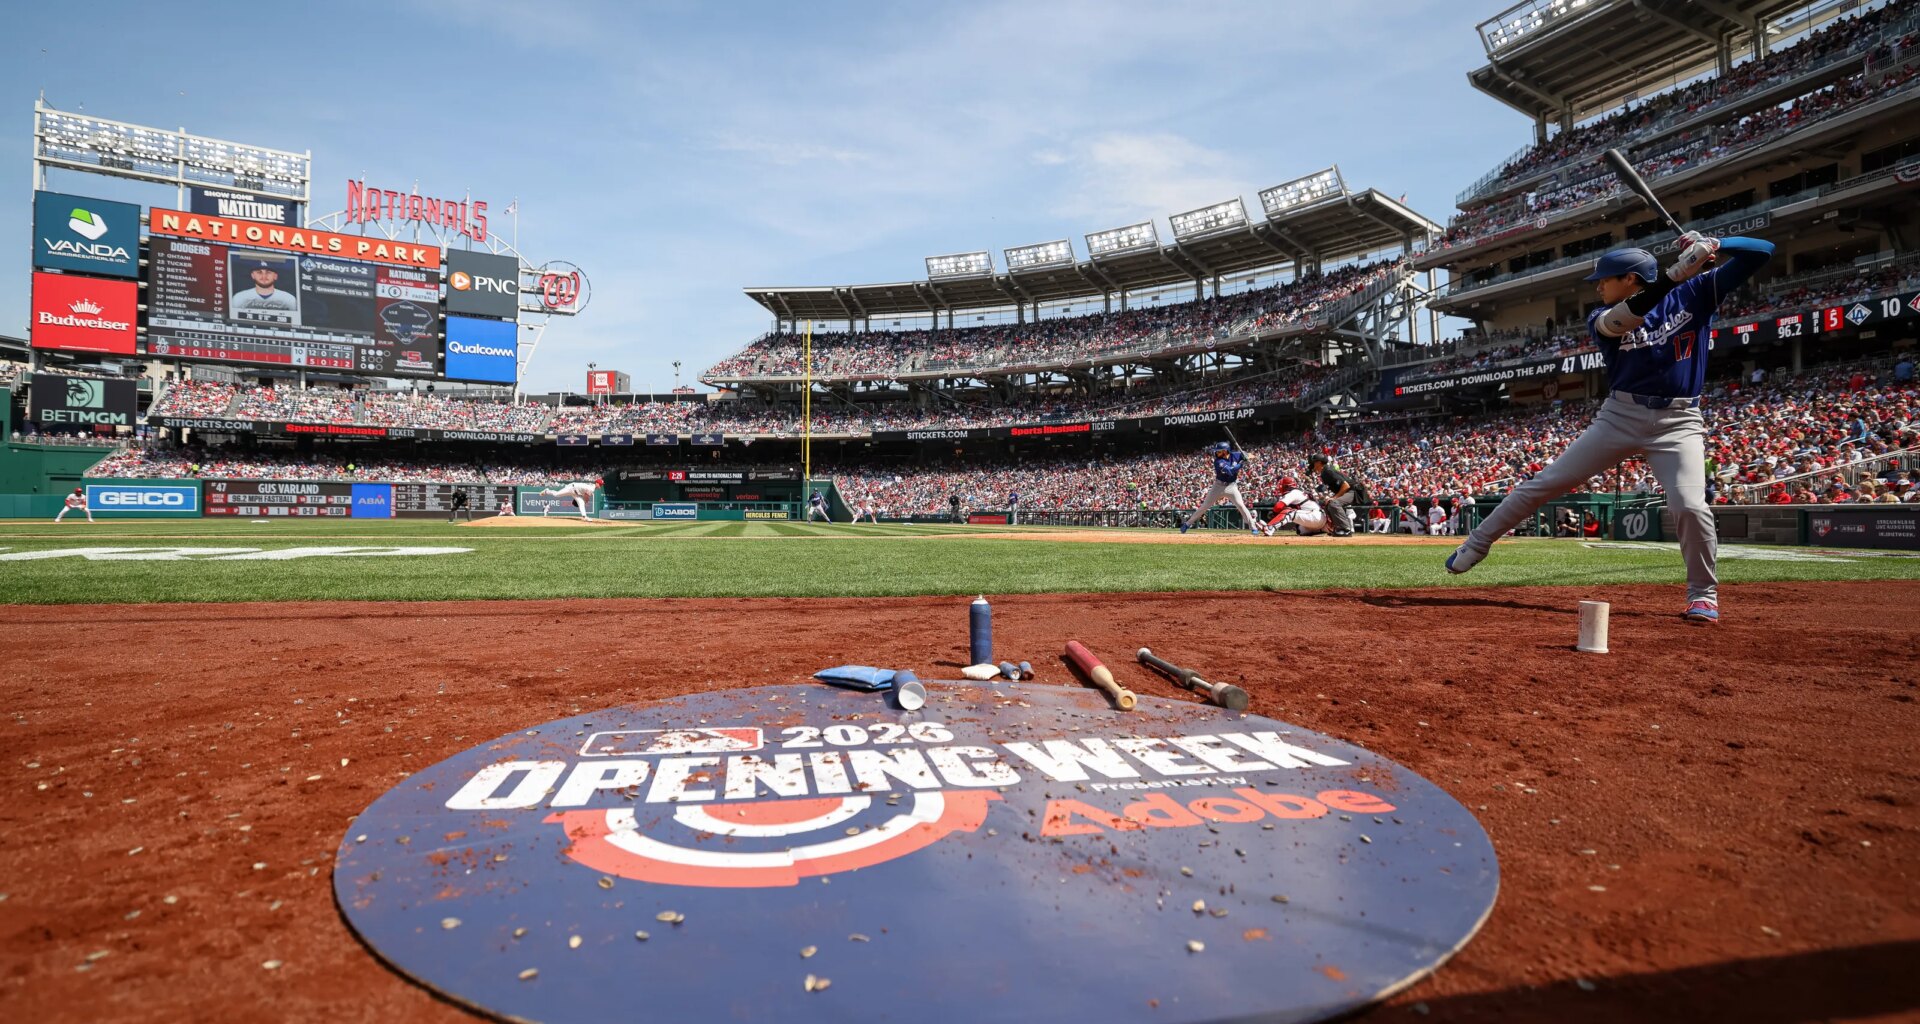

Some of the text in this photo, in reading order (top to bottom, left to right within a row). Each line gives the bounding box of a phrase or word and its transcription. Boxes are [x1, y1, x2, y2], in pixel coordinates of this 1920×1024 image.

[204, 190, 230, 199] SHOW
[218, 198, 285, 220] NATITUDE
[347, 179, 488, 242] NATIONALS
[1729, 217, 1765, 236] CLUB
[163, 214, 426, 263] NATIONALS PARK
[44, 238, 130, 259] VANDA
[170, 242, 210, 256] DODGERS
[316, 262, 368, 274] Today: 0-2
[389, 269, 426, 282] NATIONALS
[473, 278, 518, 296] PNC
[166, 308, 200, 316] FREELAND
[1881, 298, 1901, 318] 10
[39, 311, 130, 332] Budweiser
[1780, 316, 1800, 328] SPEED
[1830, 311, 1839, 328] 5
[1637, 311, 1694, 346] Angeles
[1737, 324, 1755, 334] TOTAL
[1778, 324, 1802, 340] 96.2
[1673, 331, 1696, 362] 17
[1742, 332, 1750, 345] 0
[449, 341, 514, 358] Qualcomm
[344, 360, 350, 368] 2
[1561, 352, 1607, 374] 47 VAR
[1395, 362, 1557, 396] SITICKETS.COM DOWNLOAD THE APP
[42, 409, 126, 424] BETMGM
[906, 408, 1255, 440] SITICKETS.COM Sports Illustrated TICKETS DOWNLOAD THE APP
[163, 418, 535, 442] SITICKETS.COM Sports Illustrated TICKETS DOWNLOAD THE APP
[258, 484, 320, 494] GUS VARLAND
[99, 492, 184, 506] GEICO
[358, 496, 385, 505] ABM
[782, 722, 954, 748] 2026
[445, 731, 1352, 810] OPENING WEEK
[1090, 776, 1247, 792] Presented by
[1040, 787, 1397, 837] Adobe
